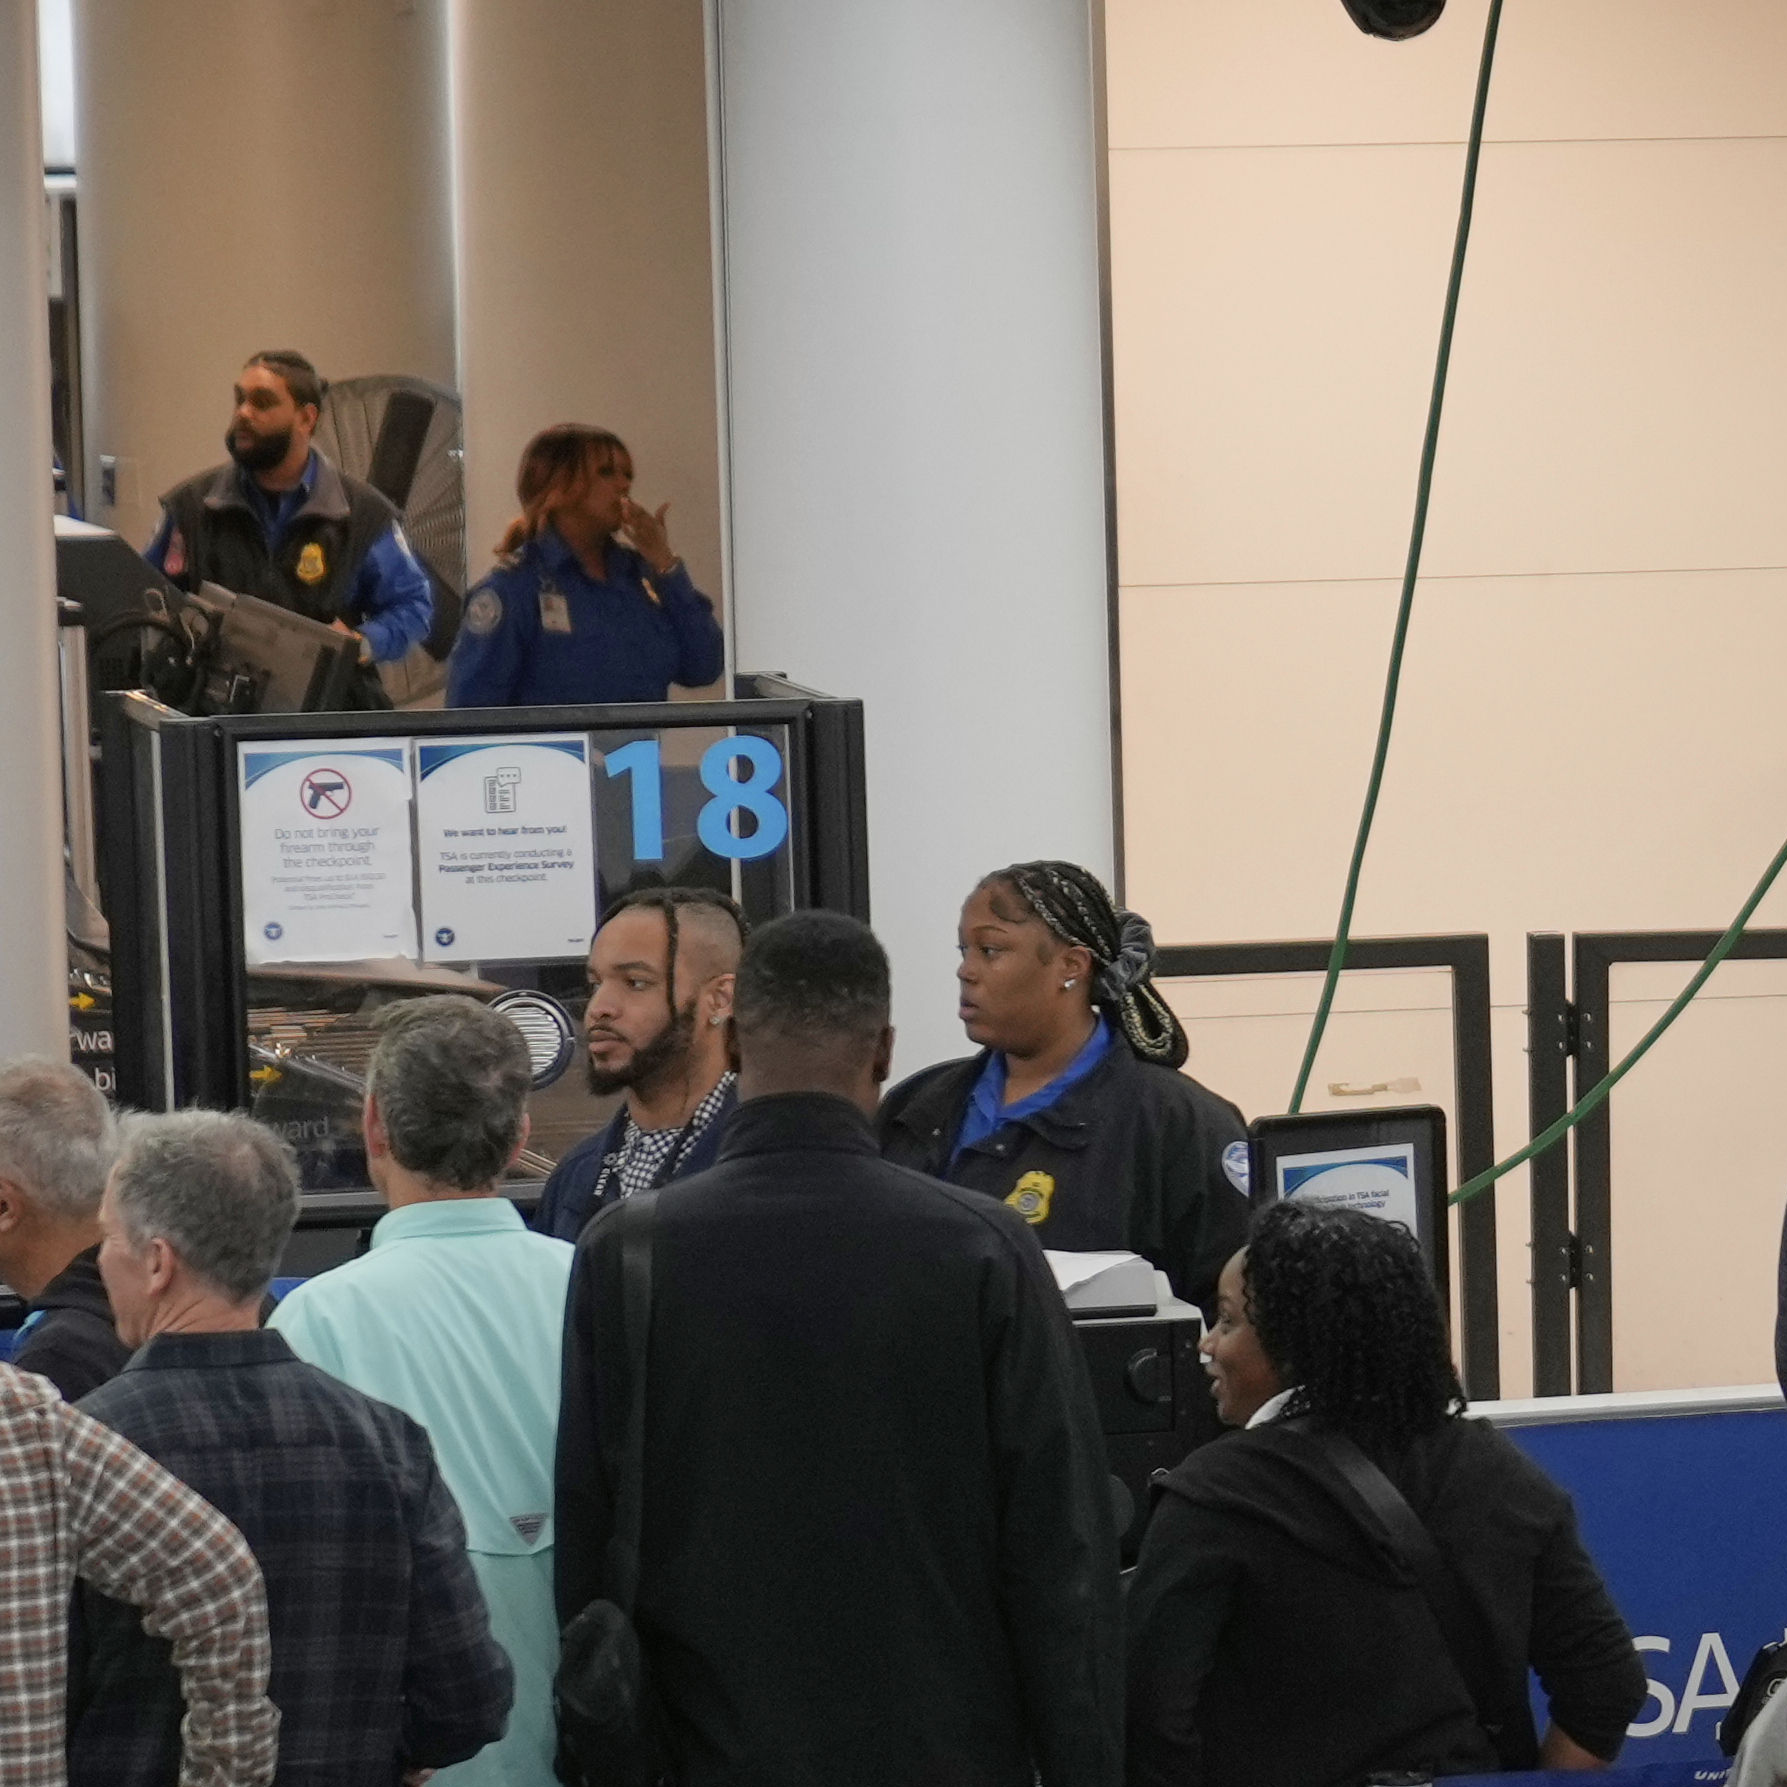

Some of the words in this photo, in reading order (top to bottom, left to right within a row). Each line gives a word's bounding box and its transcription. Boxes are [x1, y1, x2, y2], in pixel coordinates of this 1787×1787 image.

[604, 735, 789, 860] 18
[274, 828, 290, 840] Do
[294, 827, 313, 840] not
[316, 827, 349, 842] bring
[352, 826, 380, 841] your
[443, 829, 459, 838] We
[461, 828, 484, 837] want
[486, 828, 497, 836] to
[498, 827, 519, 836] hear
[521, 826, 545, 835] from
[280, 841, 325, 854] firearm
[328, 840, 375, 854] through
[440, 852, 457, 861] TSA
[460, 852, 468, 861] is
[469, 850, 511, 862] currently
[514, 849, 564, 861] conducting
[283, 856, 303, 869] the
[439, 863, 485, 874] Passenger
[488, 861, 538, 873] Experience
[541, 860, 575, 871] Survey
[465, 875, 475, 884] at
[477, 874, 493, 884] this
[1356, 1191, 1370, 1200] TSA
[1371, 1189, 1389, 1198] facial
[1625, 1632, 1741, 1738] SA
